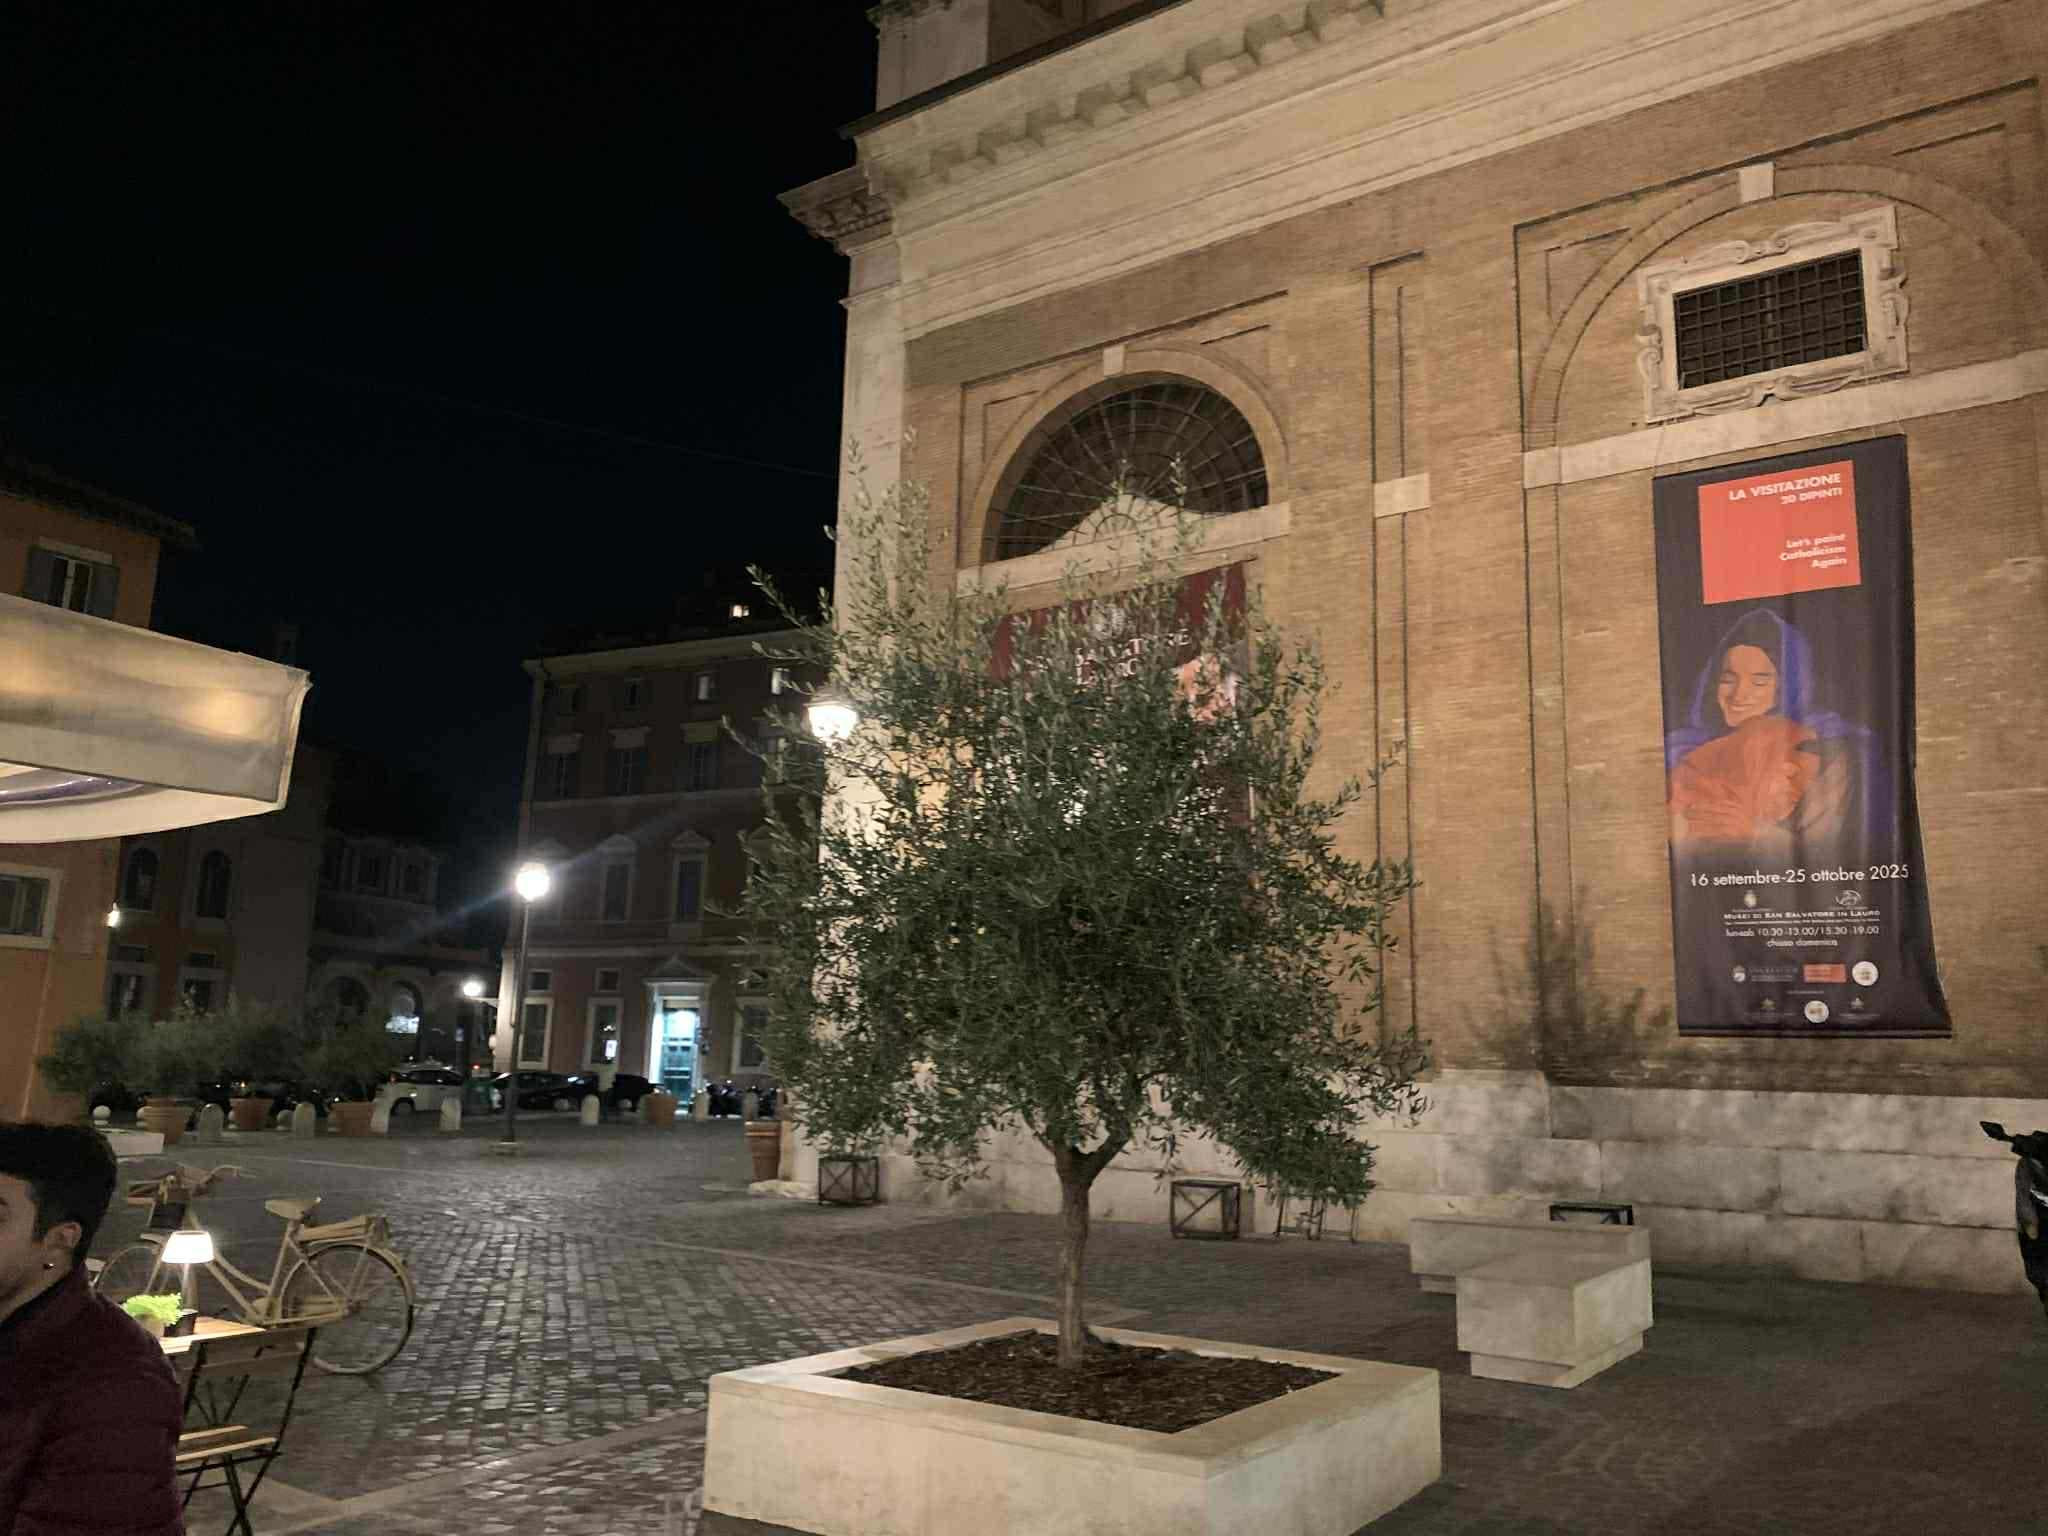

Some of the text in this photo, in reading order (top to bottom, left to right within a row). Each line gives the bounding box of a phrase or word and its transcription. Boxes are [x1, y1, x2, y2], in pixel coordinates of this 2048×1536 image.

[1728, 473, 1841, 501] LA VISITAZIONE
[1799, 487, 1843, 501] DIPINTI
[1814, 533, 1846, 547] paint
[1779, 545, 1847, 561] Catholicism
[1811, 557, 1848, 569] Again
[1691, 873, 1709, 887] 16
[1810, 866, 1865, 883] ottobre
[1869, 864, 1910, 881] 2025
[1765, 911, 1783, 919] SAN
[1784, 910, 1834, 919] SALVATORE
[1850, 909, 1881, 917] LAURO
